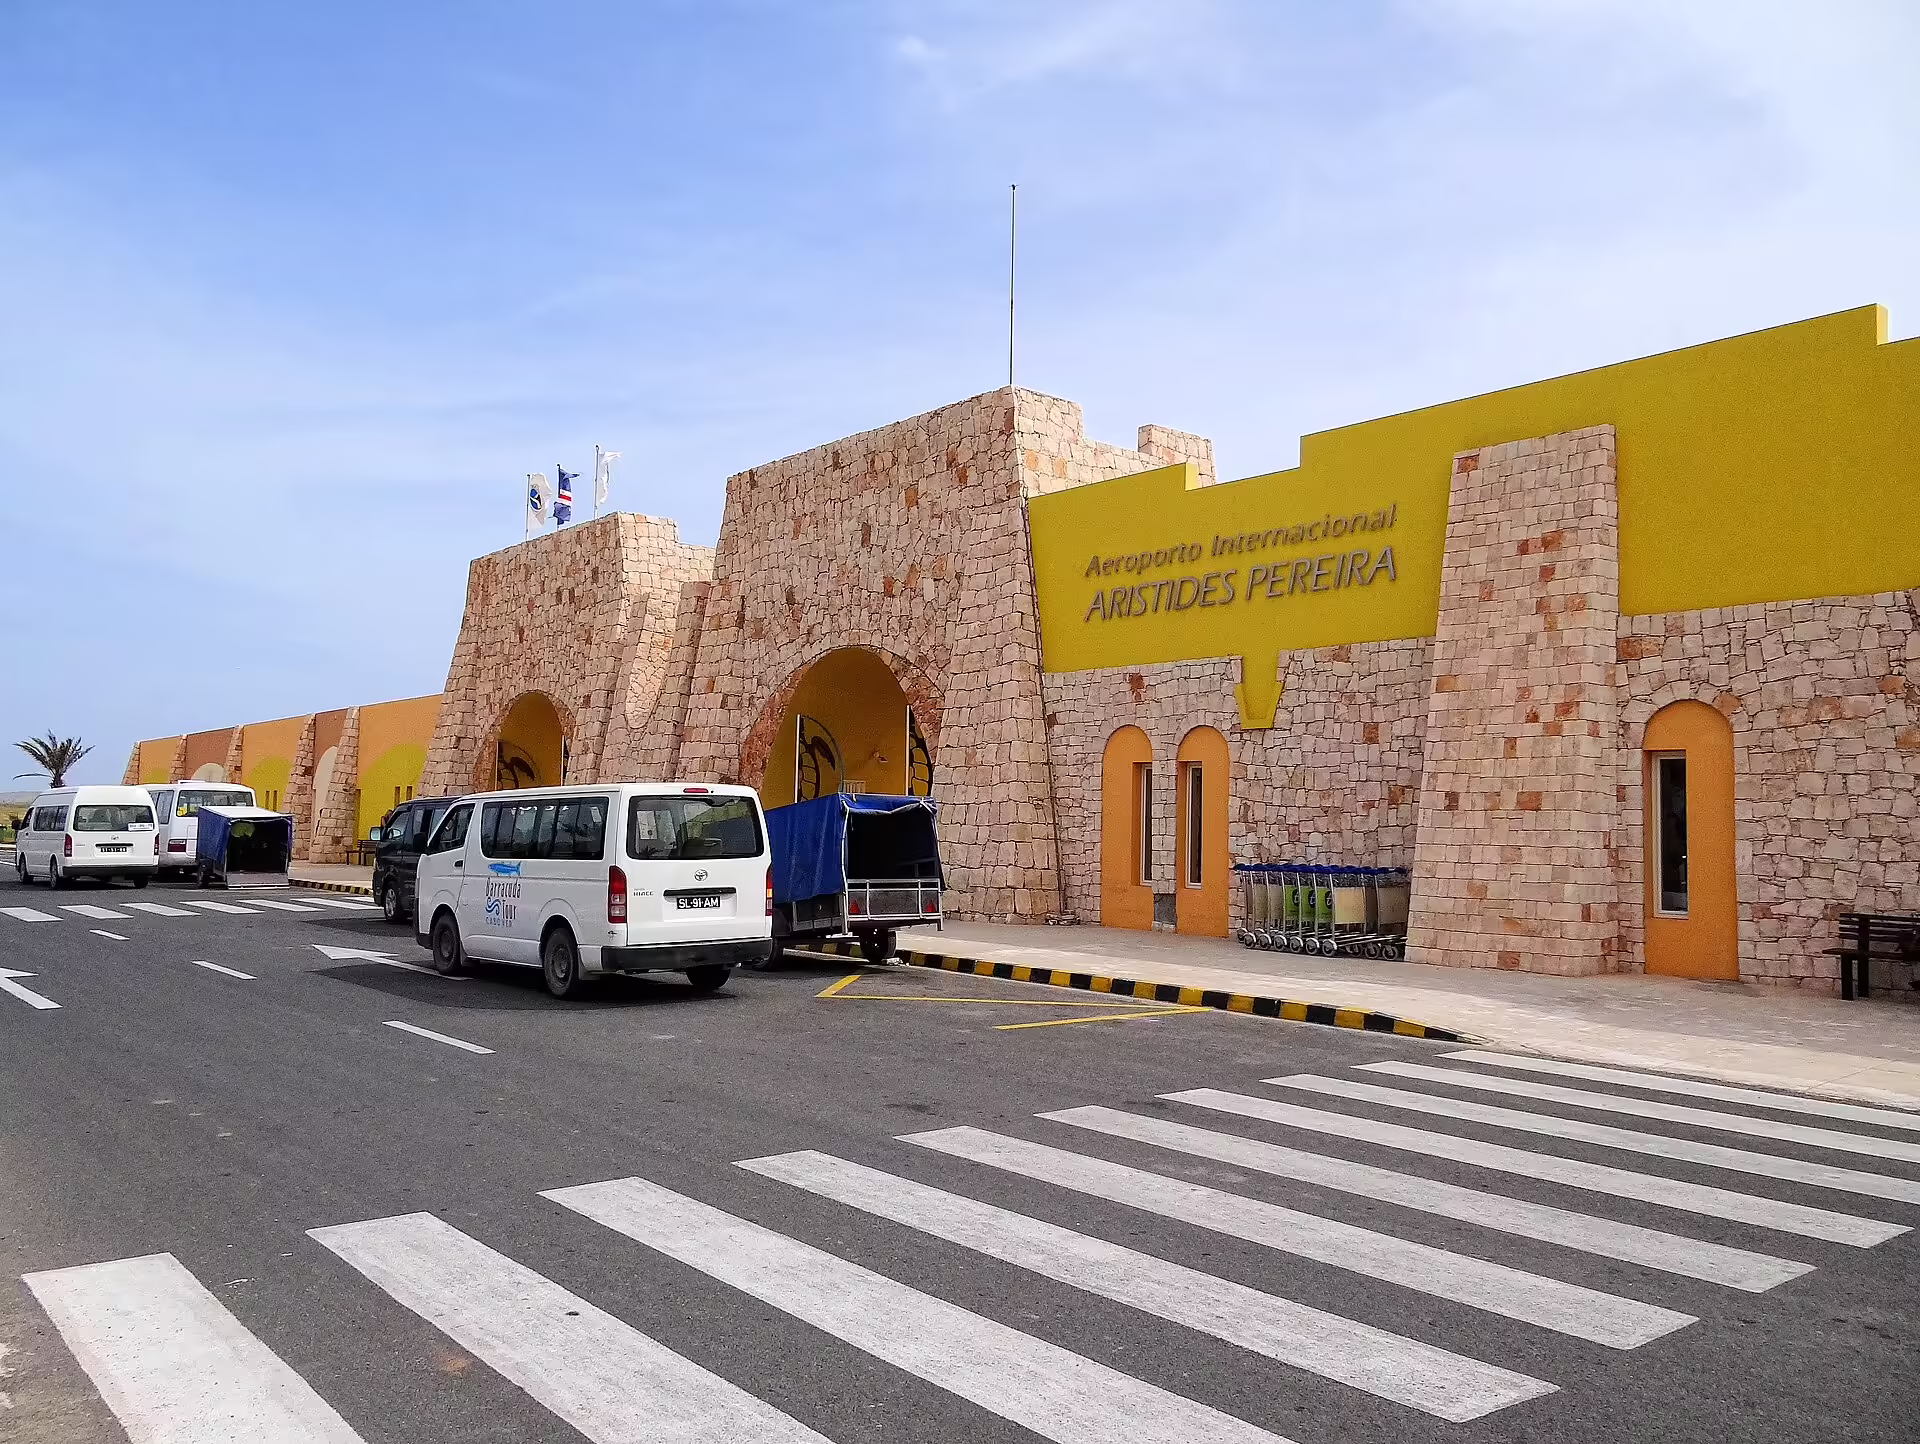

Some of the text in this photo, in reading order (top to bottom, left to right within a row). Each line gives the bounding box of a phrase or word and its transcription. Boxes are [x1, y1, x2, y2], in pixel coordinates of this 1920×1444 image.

[1085, 503, 1397, 578] Aeroporto Internacional
[1084, 545, 1397, 623] ARISTIDES PEREIRA
[502, 899, 517, 920] Tour
